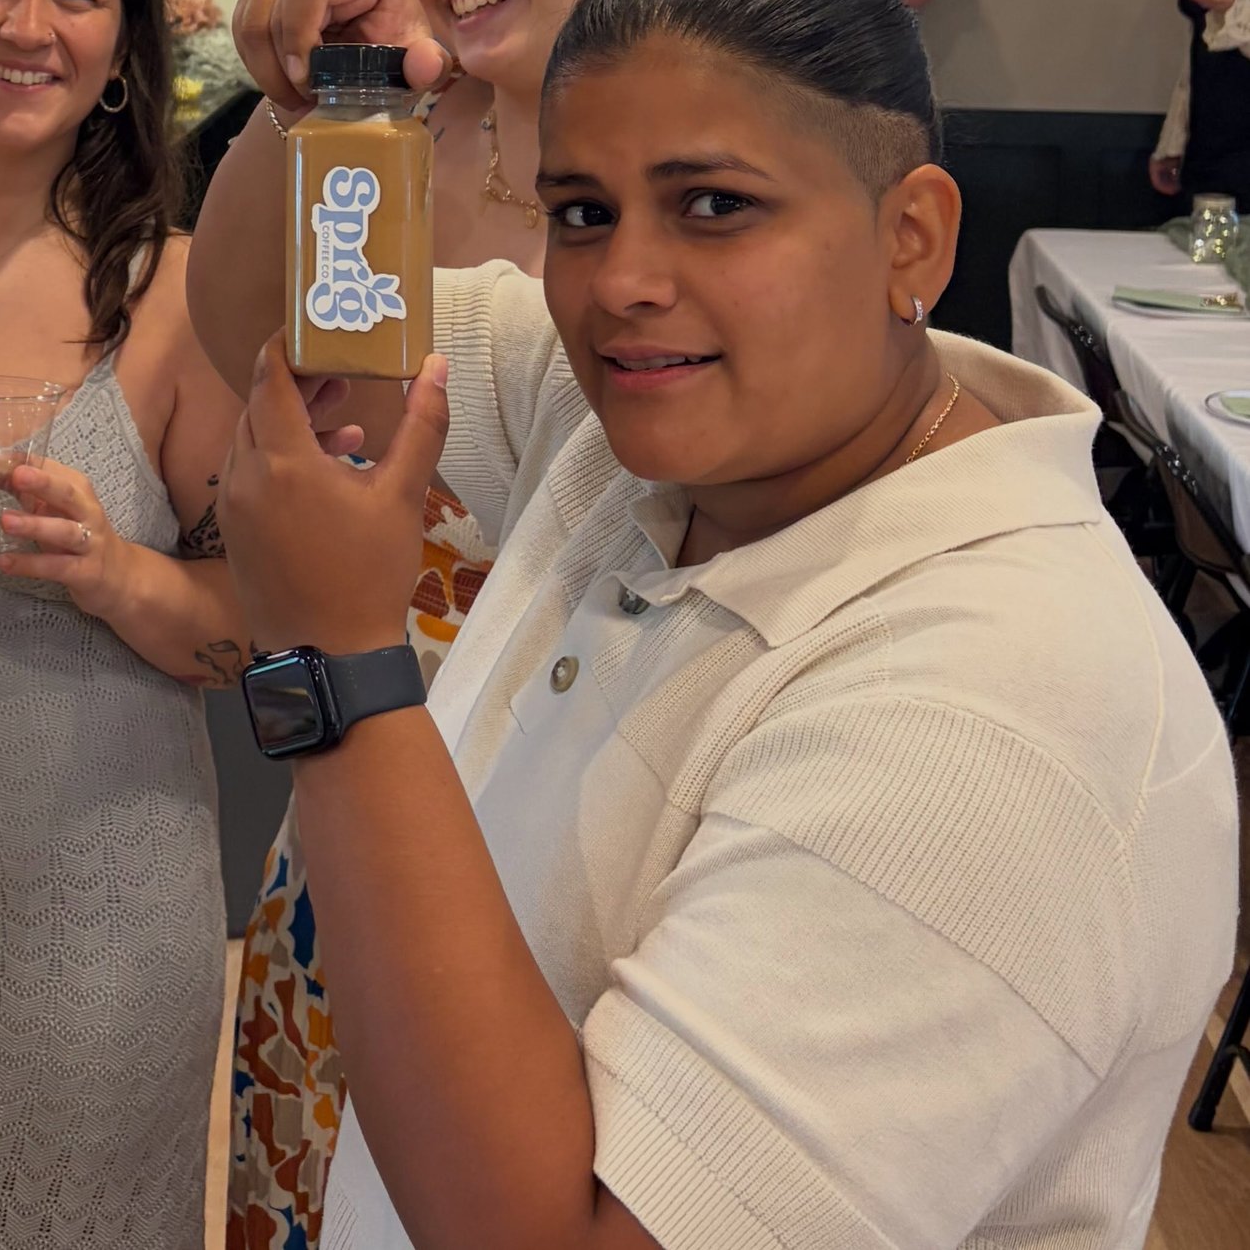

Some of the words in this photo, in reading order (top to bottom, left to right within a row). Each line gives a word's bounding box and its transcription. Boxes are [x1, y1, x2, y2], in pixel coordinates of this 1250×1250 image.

[312, 168, 376, 324] Sprig
[321, 225, 330, 262] COFFEE
[321, 263, 330, 282] CO.
